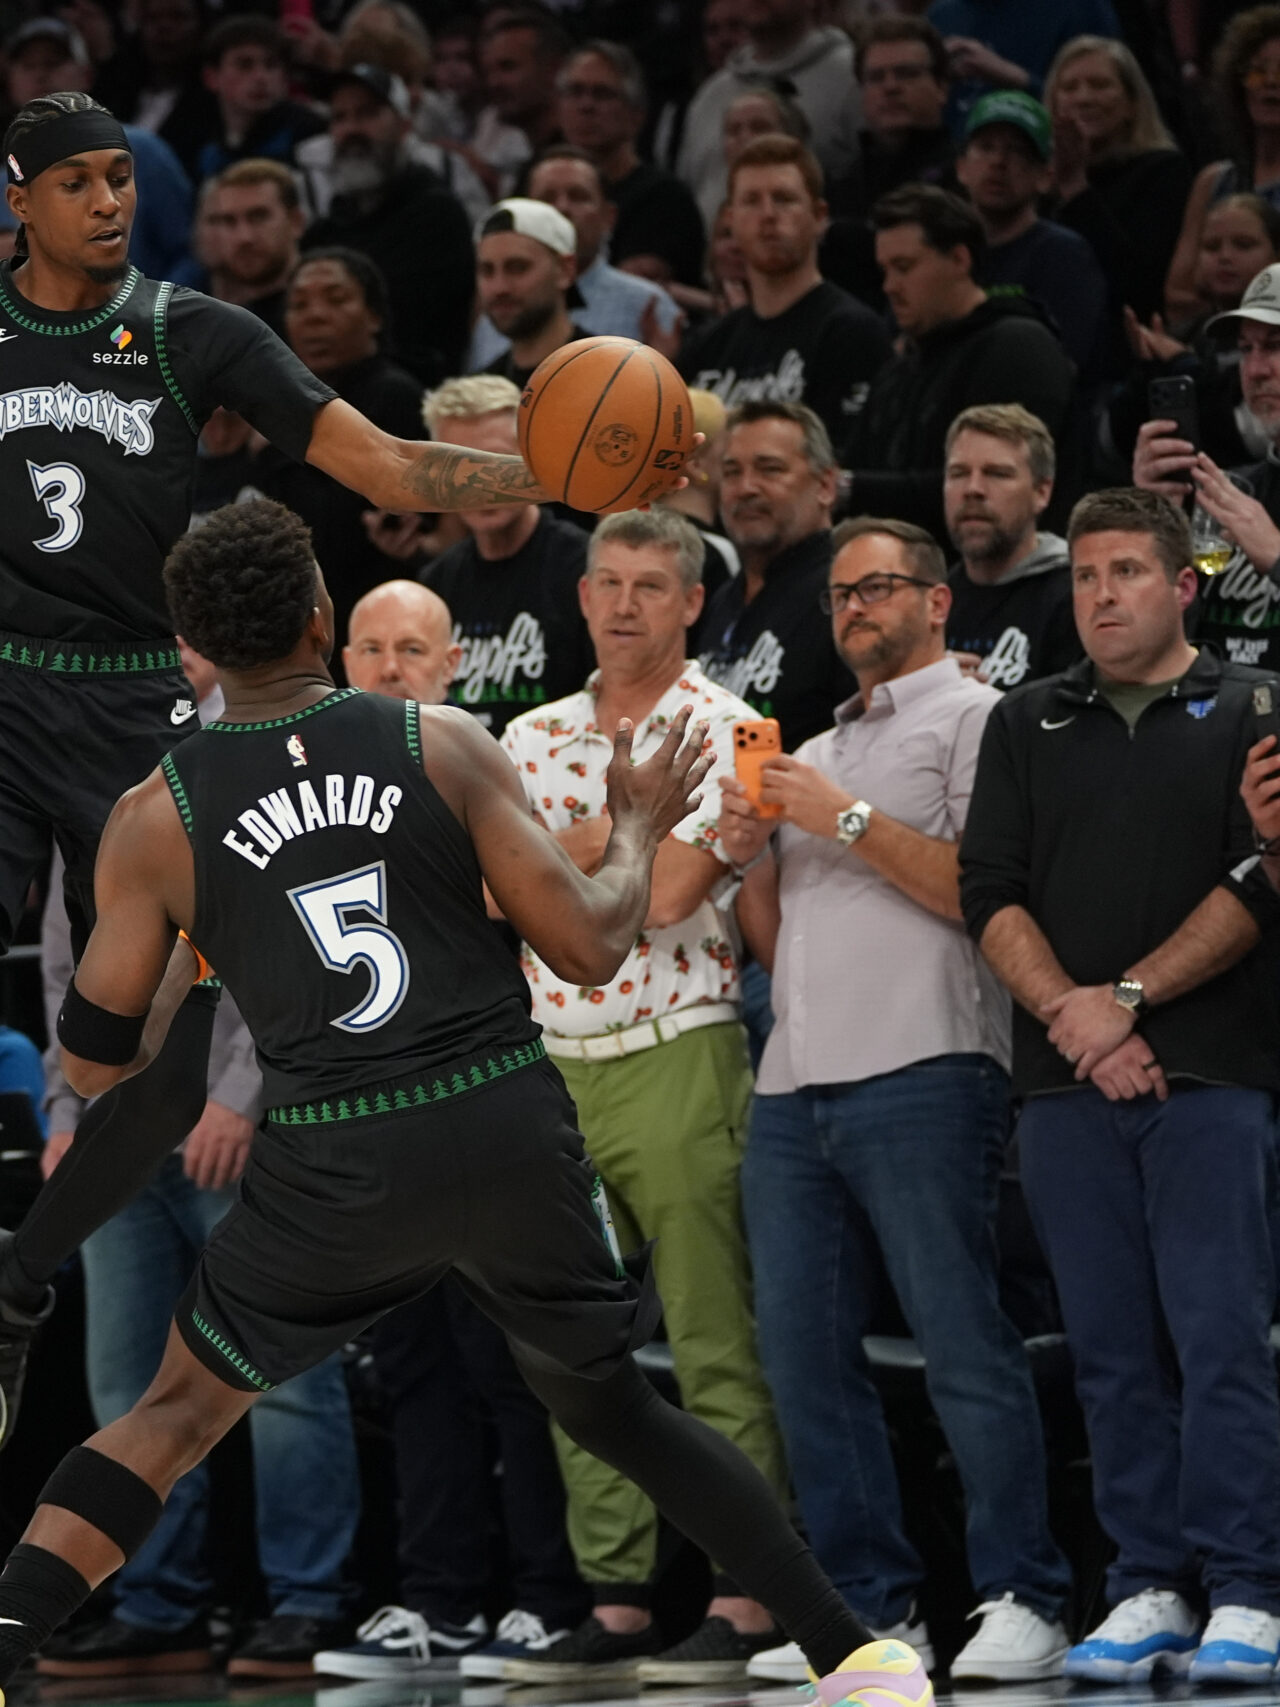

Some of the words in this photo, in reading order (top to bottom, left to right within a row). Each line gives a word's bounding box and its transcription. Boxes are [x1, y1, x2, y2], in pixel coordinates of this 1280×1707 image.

[93, 351, 148, 365] sezzle
[26, 459, 86, 553] 3
[222, 774, 403, 870] EDWARDS
[285, 859, 411, 1034] 5
